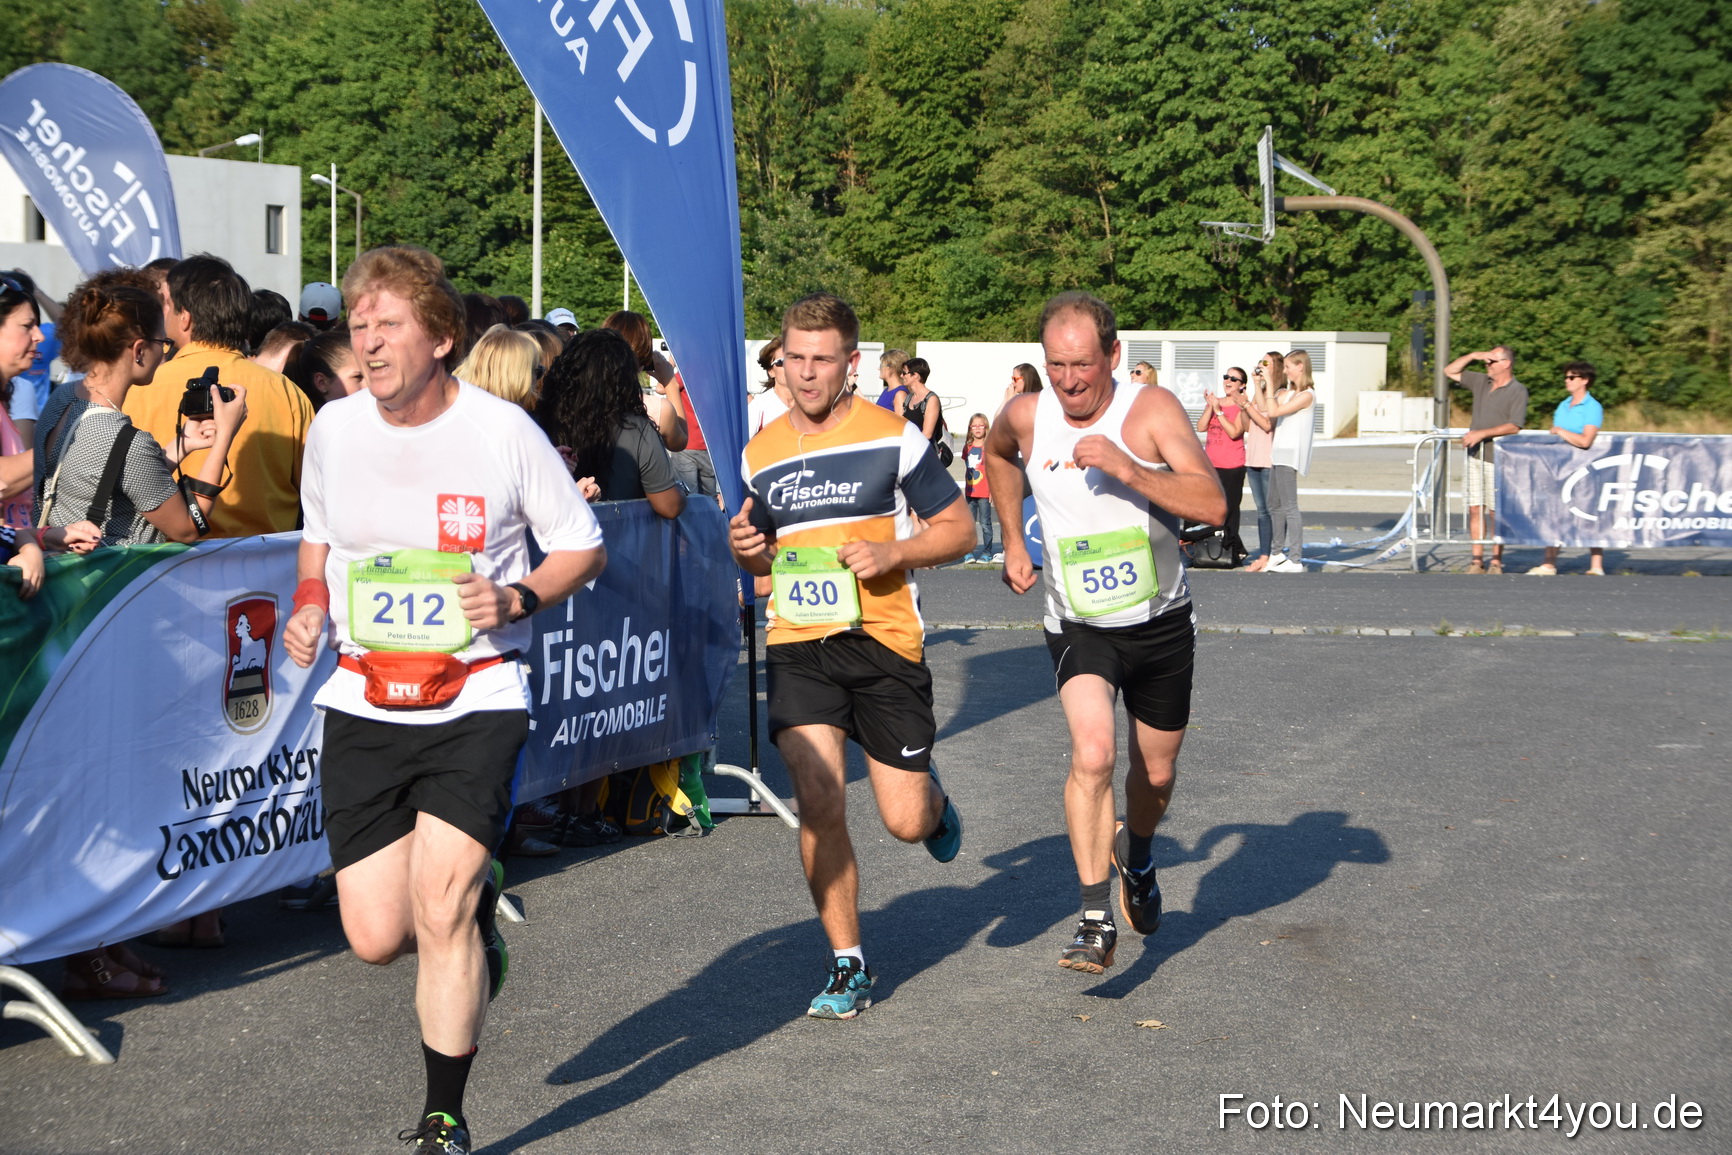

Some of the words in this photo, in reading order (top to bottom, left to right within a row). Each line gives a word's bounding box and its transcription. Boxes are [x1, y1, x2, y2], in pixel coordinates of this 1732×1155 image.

[781, 479, 863, 504] Fischer
[790, 496, 856, 511] AUTOMOBILE
[189, 503, 206, 529] SONY
[1082, 561, 1138, 594] 583
[788, 580, 838, 606] 430
[372, 592, 445, 625] 212
[390, 683, 419, 697] LTU
[234, 699, 259, 721] 1628
[550, 694, 667, 748] AUTOMOBILE
